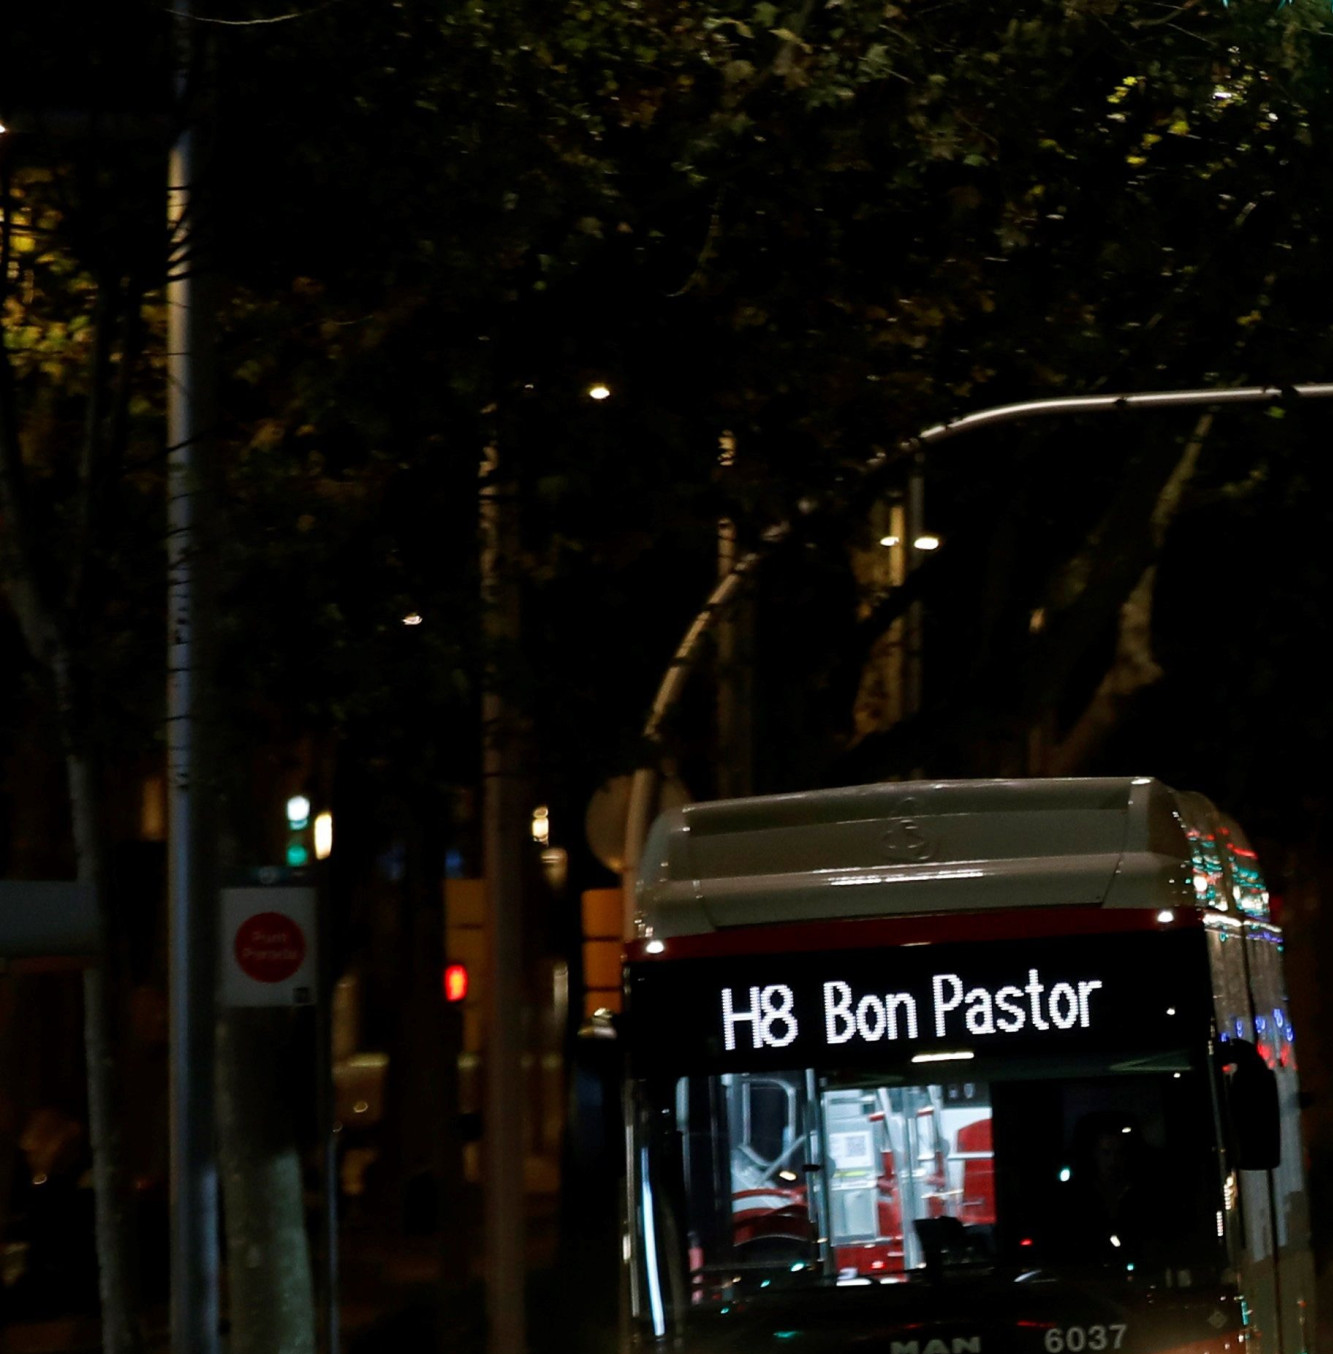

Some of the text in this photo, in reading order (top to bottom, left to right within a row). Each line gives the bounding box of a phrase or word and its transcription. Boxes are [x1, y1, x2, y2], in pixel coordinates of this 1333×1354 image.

[721, 968, 1102, 1050] H8 Bon Pastor
[1043, 1323, 1128, 1354] 6037
